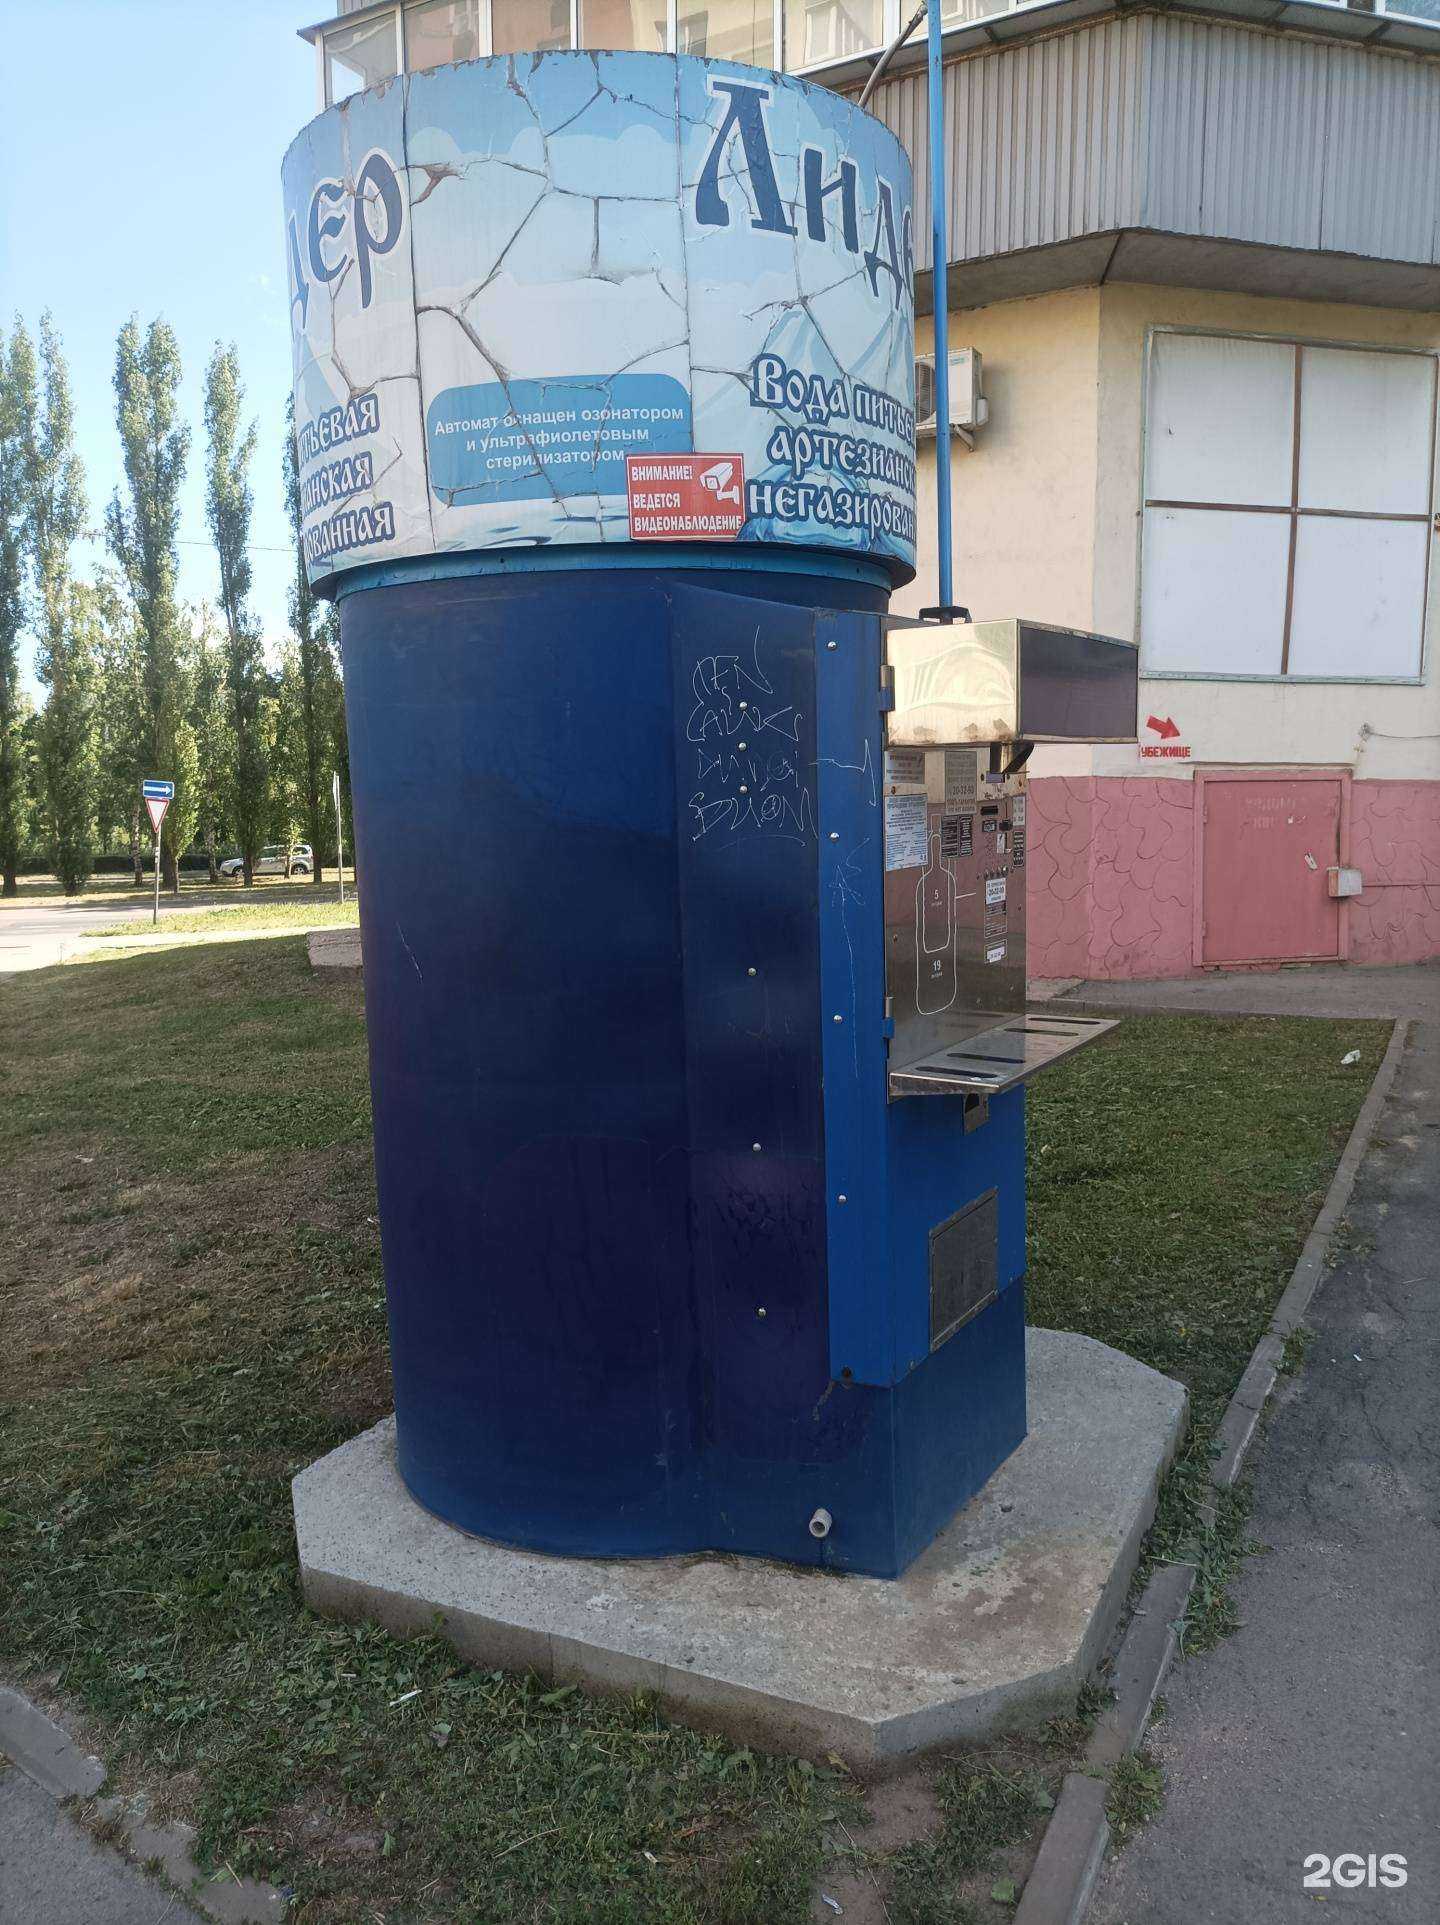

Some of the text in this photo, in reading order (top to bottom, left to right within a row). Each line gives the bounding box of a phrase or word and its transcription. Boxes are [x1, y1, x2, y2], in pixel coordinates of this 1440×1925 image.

[755, 355, 849, 421] Вода
[434, 406, 684, 435] Автомат оснащен озонатором
[466, 427, 649, 453] и ультрафиолетовым
[486, 448, 626, 471] стерилизатором
[631, 465, 693, 481] ВНИМАНИЕ!
[633, 492, 681, 511] ВЕДЕТСЯ
[634, 515, 742, 534] ВИДЕОНАБЛЮДЕНИЕ
[1141, 746, 1192, 758] УБЕЖИЩЕ
